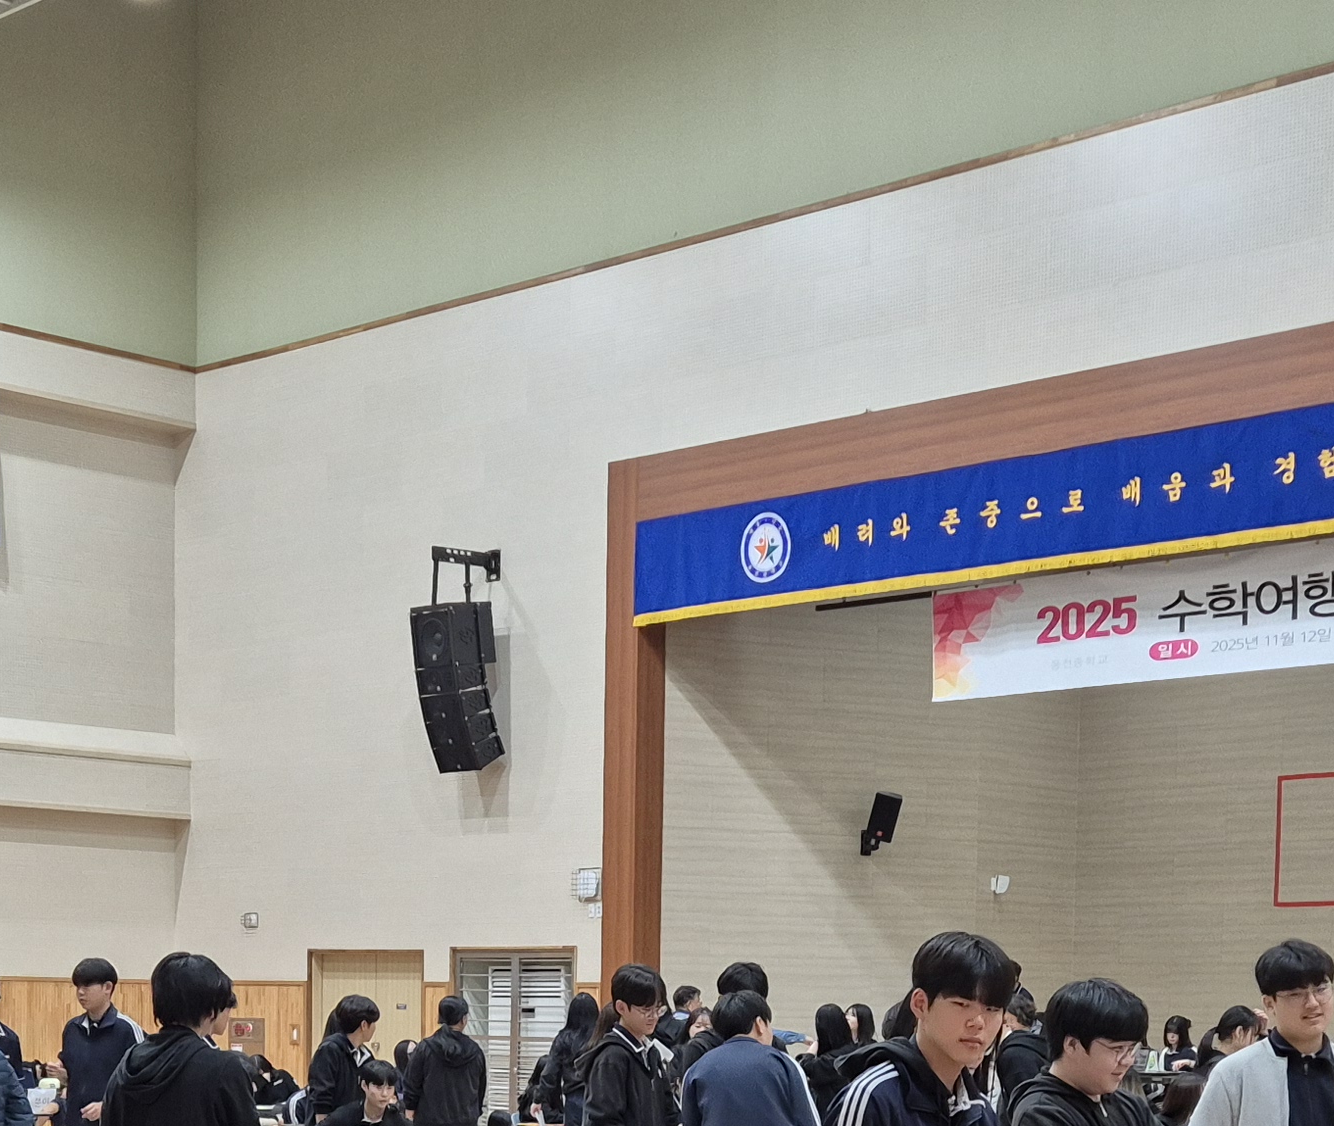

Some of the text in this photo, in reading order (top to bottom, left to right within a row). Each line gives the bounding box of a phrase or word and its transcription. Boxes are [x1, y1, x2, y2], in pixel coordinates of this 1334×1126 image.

[822, 512, 912, 552] 배려와
[938, 489, 1086, 536] 존중으로
[1121, 462, 1236, 508] 배움과
[1036, 594, 1139, 645] 2025
[1157, 639, 1193, 659] 일시
[1210, 627, 1332, 654] 2025년 11월 12일
